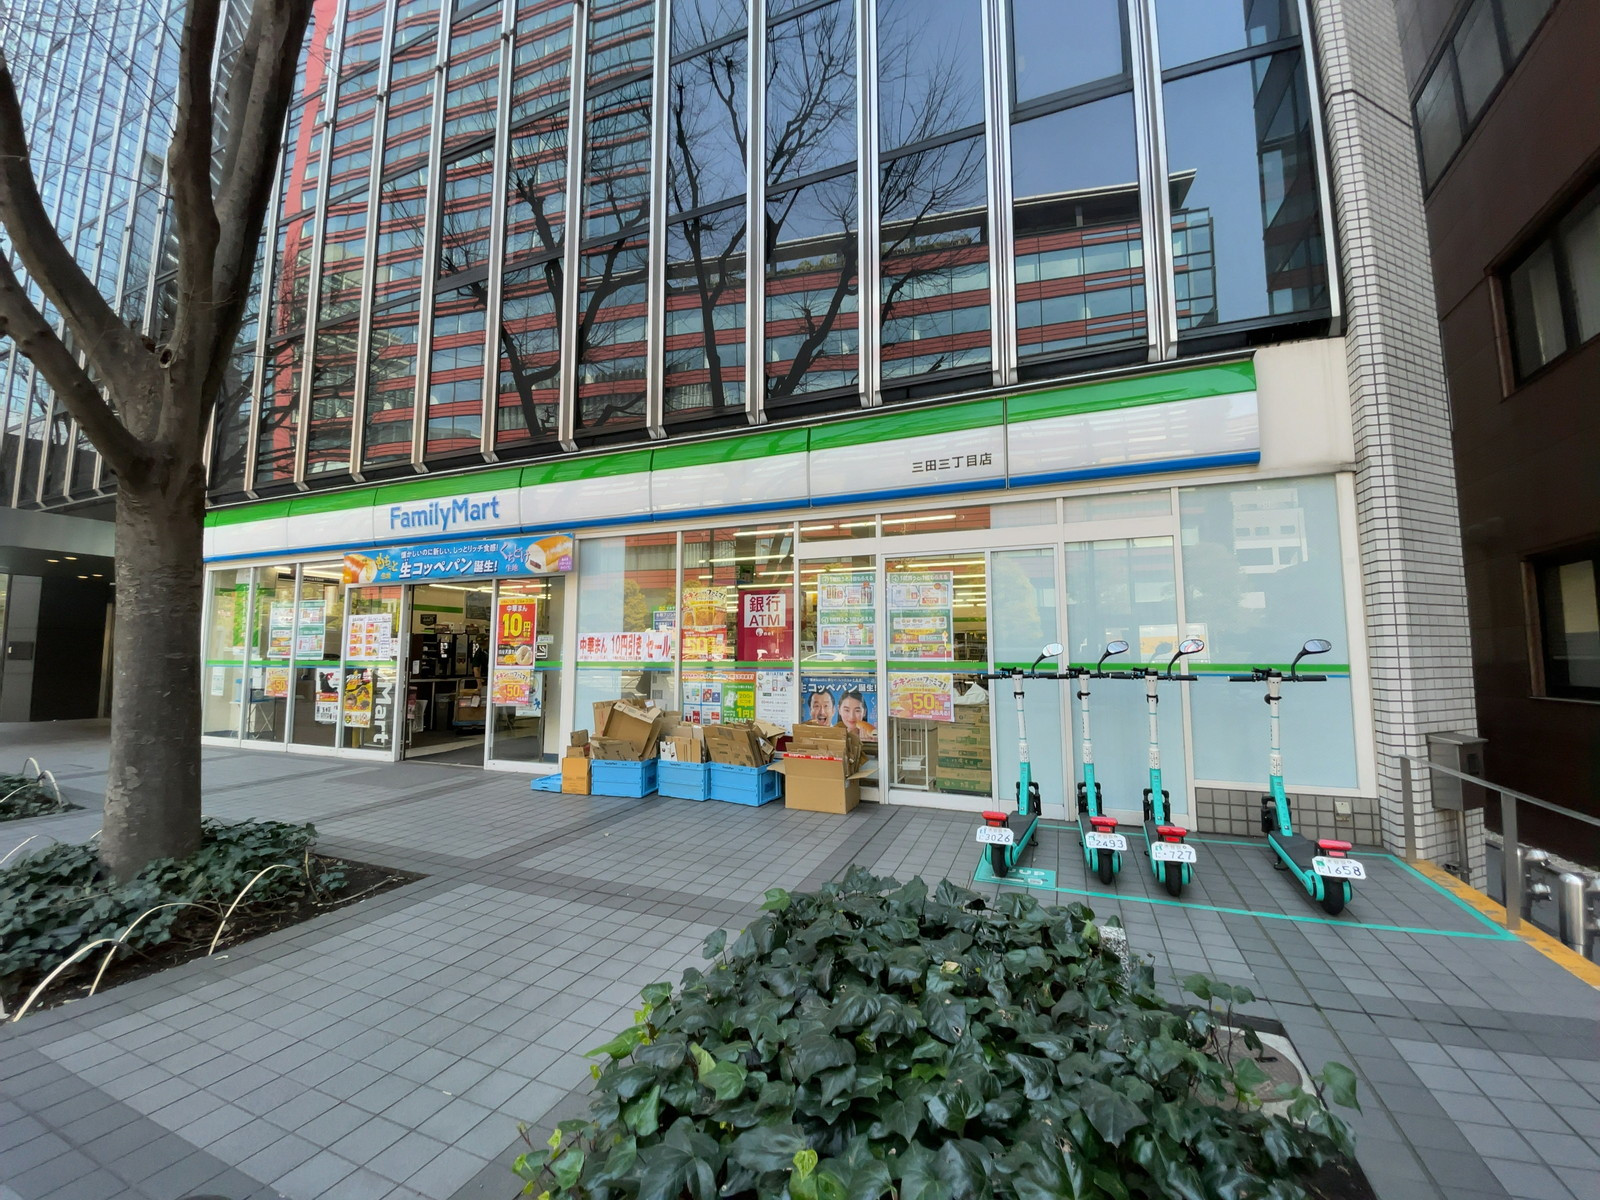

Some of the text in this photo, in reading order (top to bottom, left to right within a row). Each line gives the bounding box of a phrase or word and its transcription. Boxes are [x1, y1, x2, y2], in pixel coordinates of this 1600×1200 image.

[911, 453, 992, 473] 三田三丁目店
[390, 496, 500, 531] FamilyMart
[749, 595, 781, 613] 銀行
[749, 614, 781, 627] ATM
[580, 633, 671, 658] 中華まん 10円引き セール
[913, 693, 935, 710] 50
[985, 833, 1011, 842] 3026
[1096, 839, 1124, 849] 2493
[1327, 864, 1362, 877] 1658
